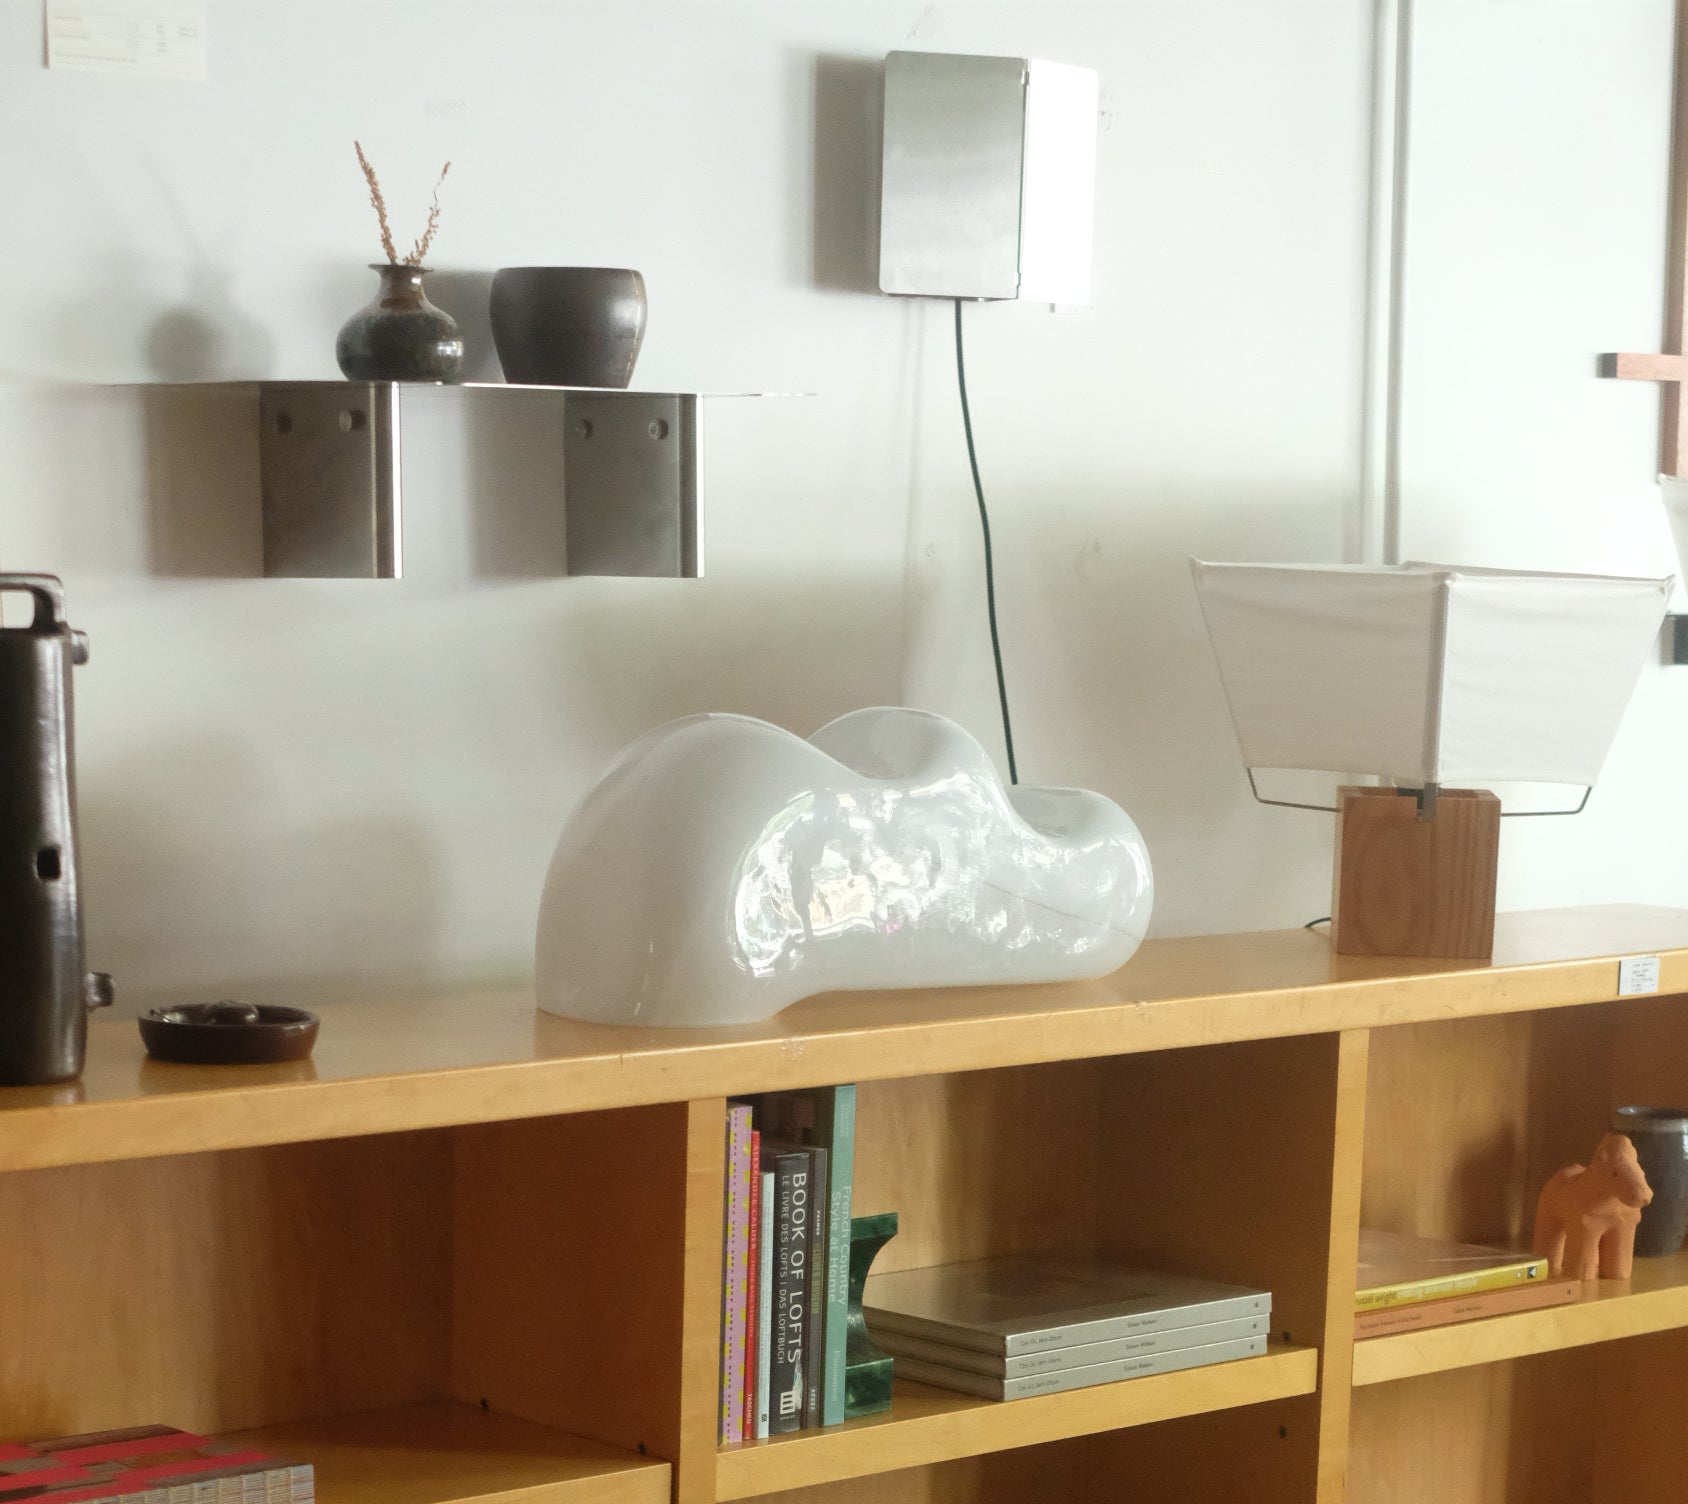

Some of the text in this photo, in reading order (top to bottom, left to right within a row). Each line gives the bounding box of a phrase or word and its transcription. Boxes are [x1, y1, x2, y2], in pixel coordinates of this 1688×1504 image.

[782, 1175, 790, 1187] LE
[781, 1191, 790, 1219] LIVRE
[780, 1223, 789, 1243] DES
[828, 1191, 841, 1304] Style at Home
[838, 1185, 852, 1306] French Country
[779, 1247, 788, 1278] LOFTS
[787, 1172, 807, 1364] BOOK OF LOFTS
[778, 1288, 787, 1310] DAS
[776, 1313, 786, 1364] LOFTBUCH
